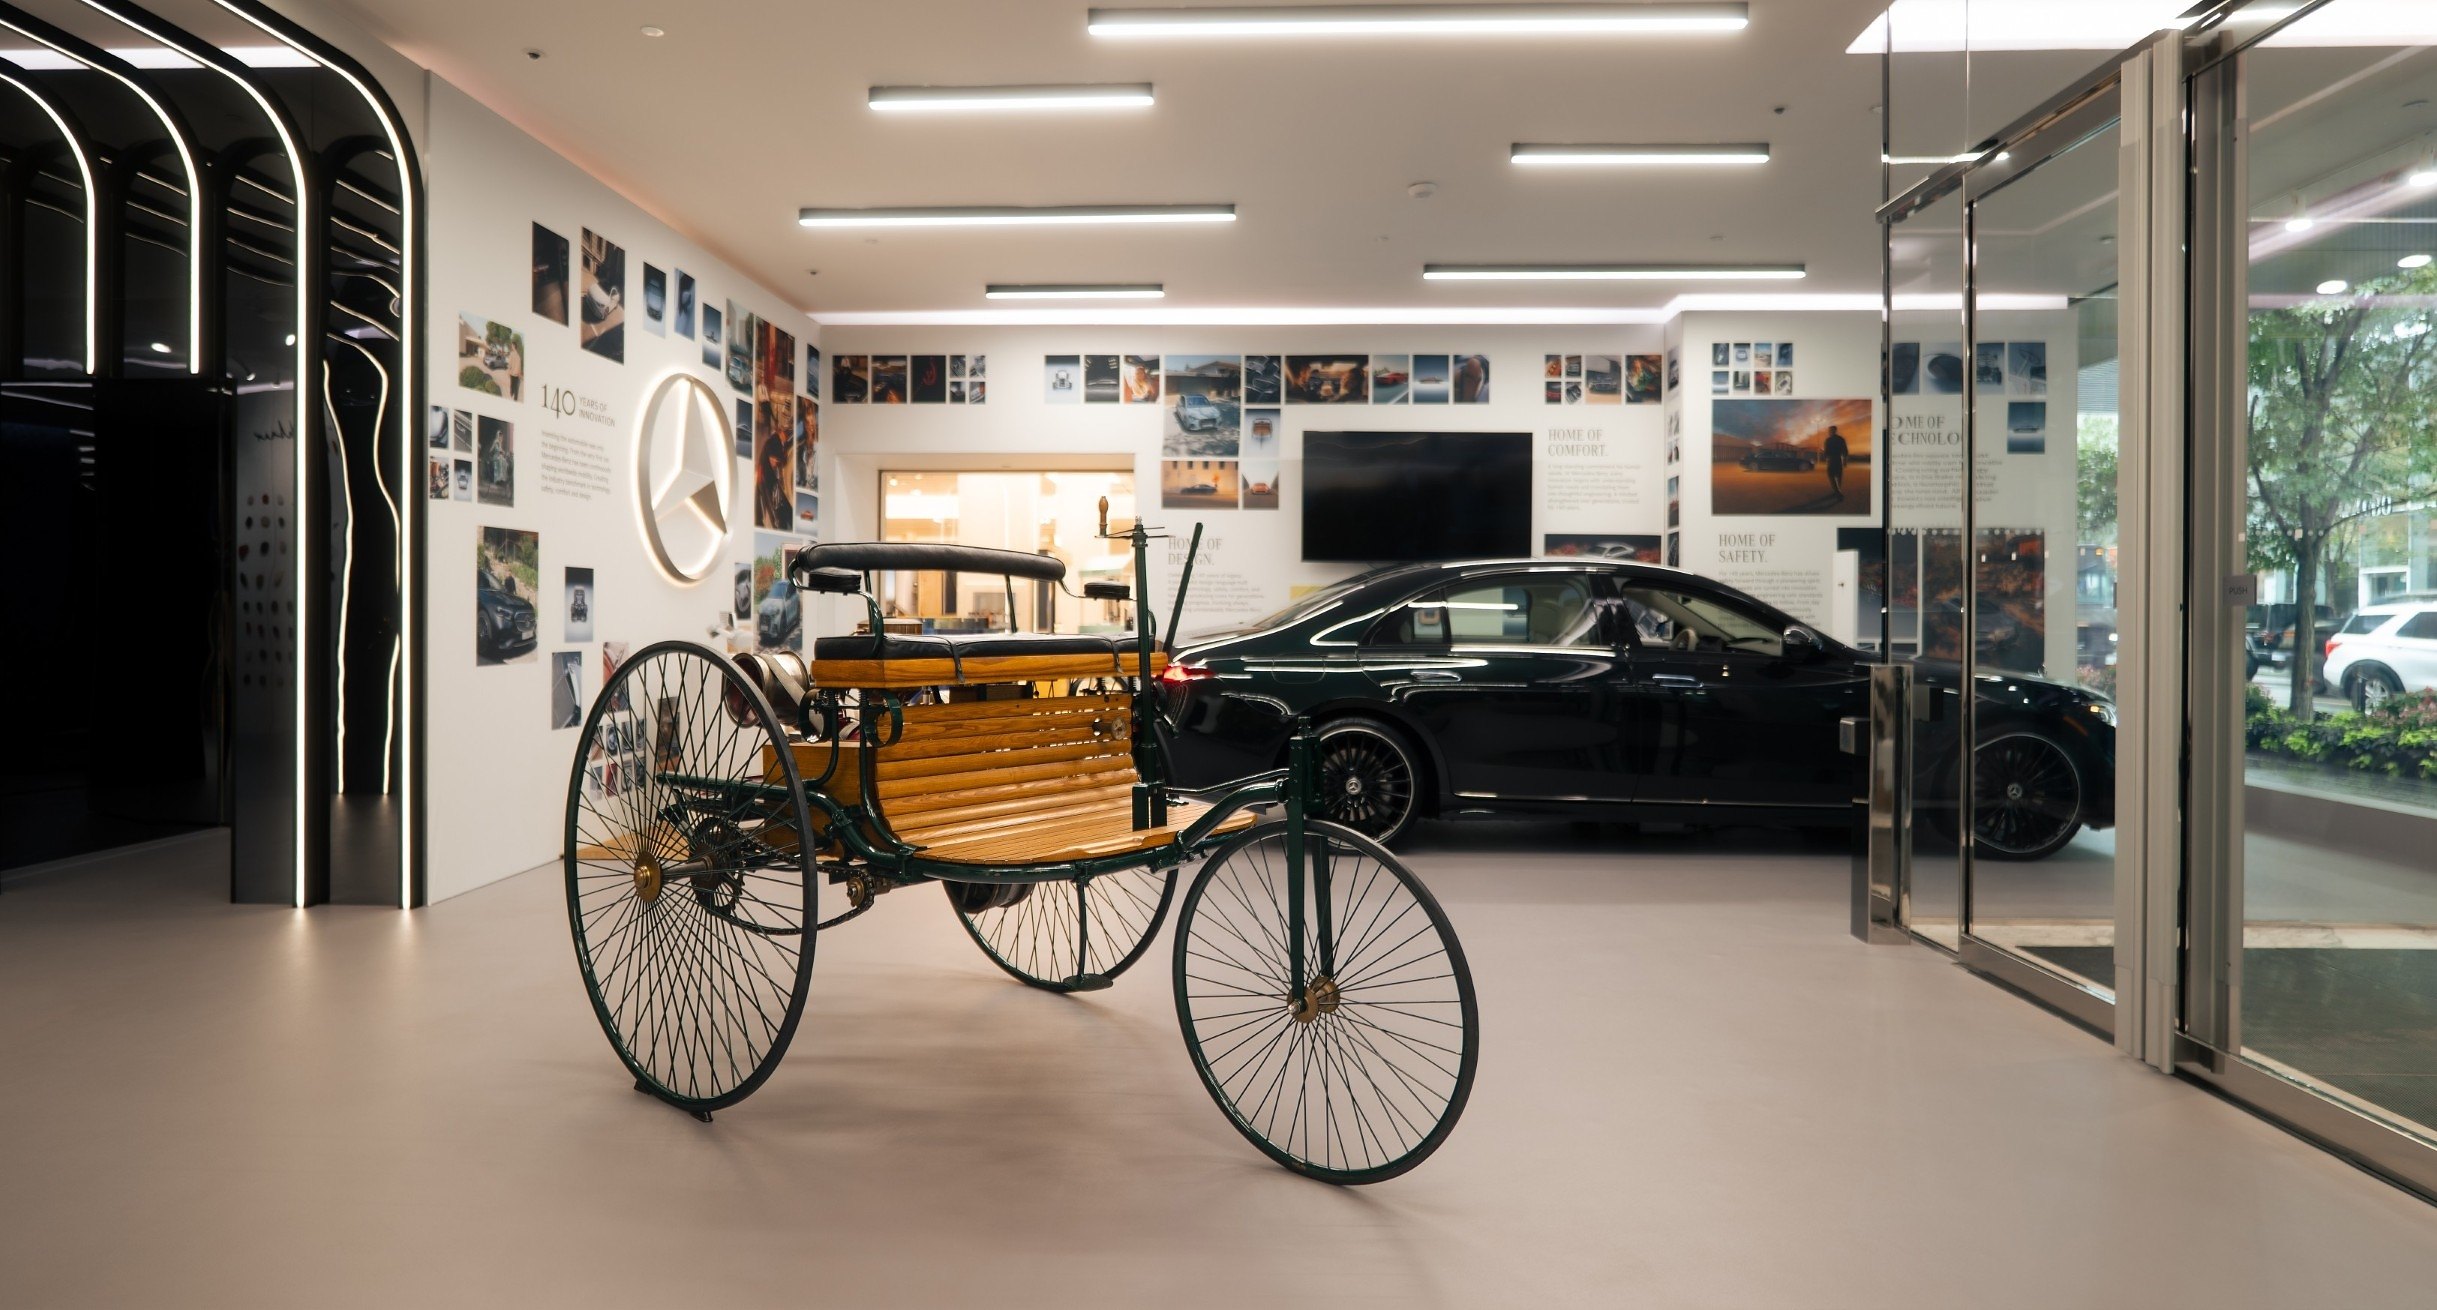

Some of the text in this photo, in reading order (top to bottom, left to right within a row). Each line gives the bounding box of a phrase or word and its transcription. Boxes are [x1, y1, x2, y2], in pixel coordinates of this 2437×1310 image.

[541, 383, 576, 420] 140
[579, 397, 608, 413] YEARS OF
[578, 409, 616, 428] INNOVATION
[1927, 416, 1945, 429] OF
[1548, 429, 1603, 441] HOME OF
[1206, 537, 1222, 550] OF
[1719, 534, 1776, 547] HOME OF
[1168, 553, 1215, 565] DESGN.
[1718, 550, 1768, 563] SAFETY.
[2228, 586, 2248, 595] PUSH
